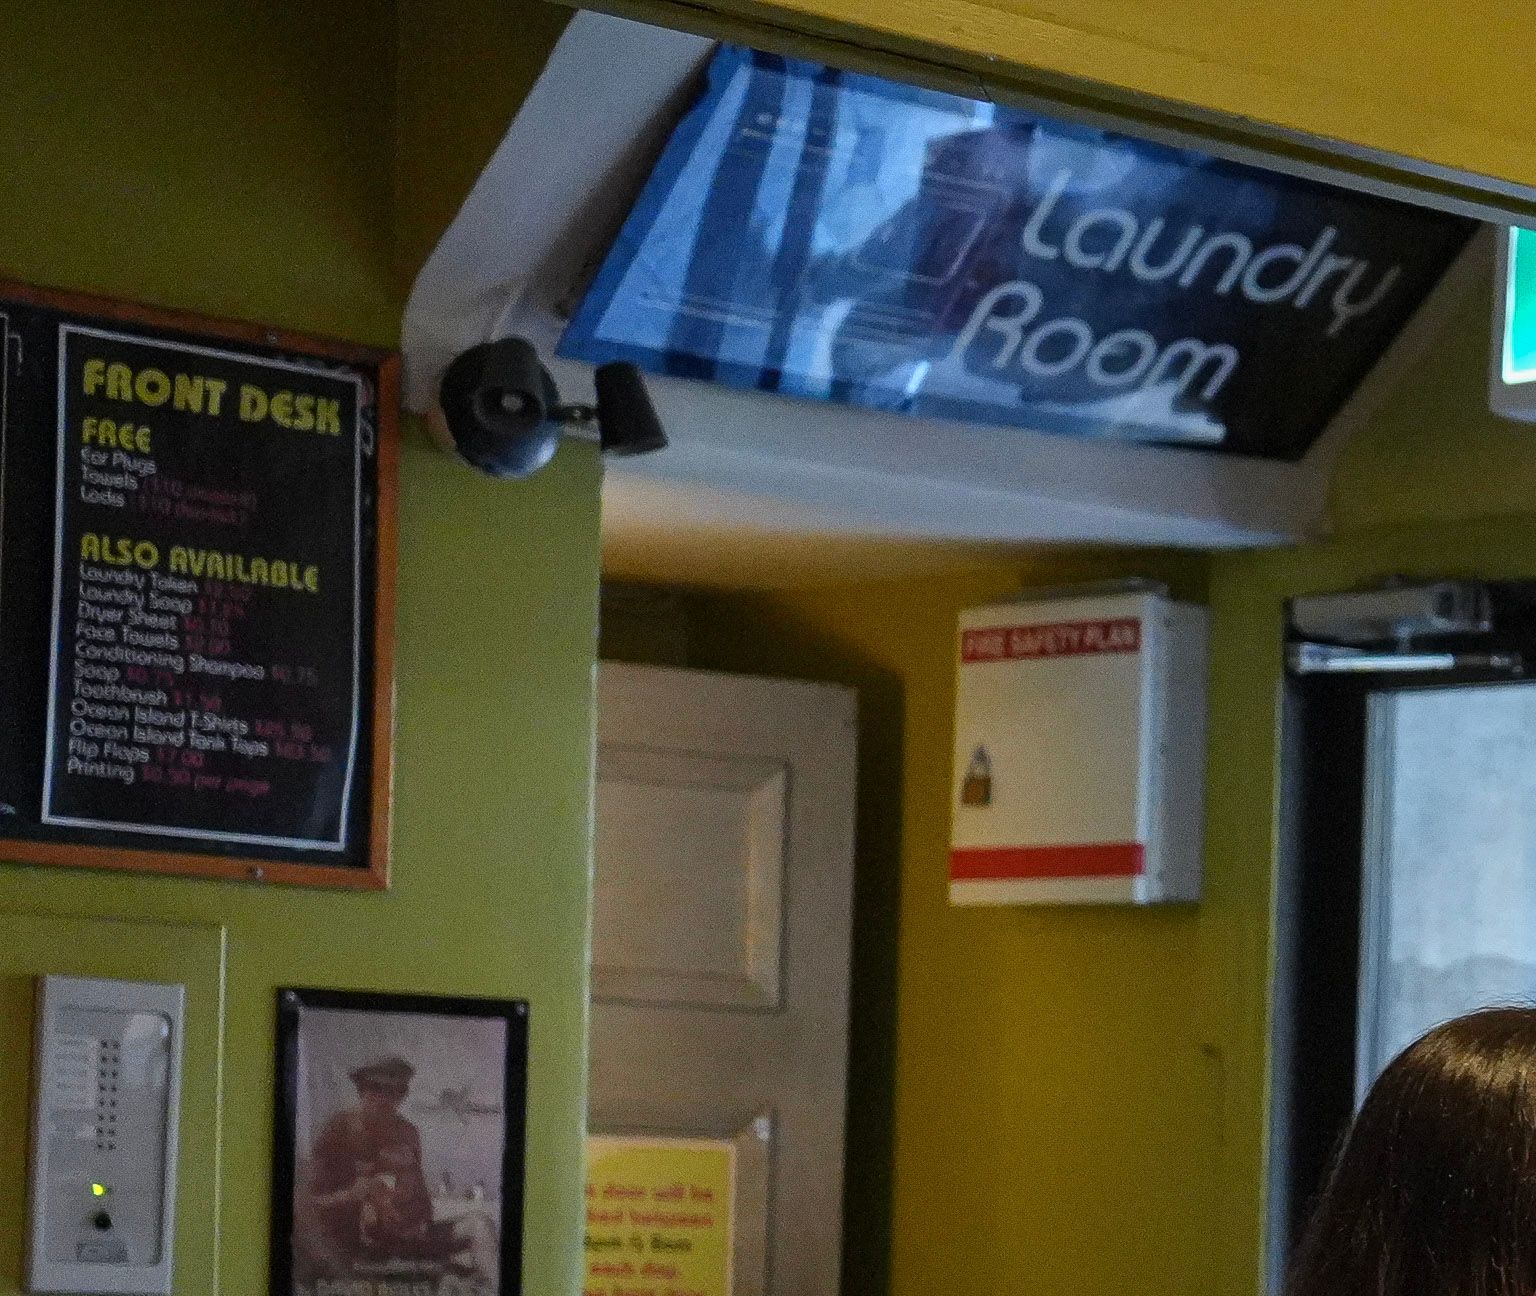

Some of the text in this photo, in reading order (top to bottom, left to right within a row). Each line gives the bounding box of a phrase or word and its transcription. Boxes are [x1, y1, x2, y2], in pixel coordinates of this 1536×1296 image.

[1022, 168, 1400, 337] Laundry
[955, 280, 1240, 400] Room
[82, 358, 338, 436] FRONT DESK
[82, 416, 151, 454] FREE
[82, 464, 138, 490] Towels
[112, 452, 157, 477] Plugs
[80, 563, 144, 589] Laundry
[81, 533, 159, 570] ALSO
[168, 545, 319, 592] AVAILABLE
[79, 600, 122, 622] Dryer
[80, 581, 144, 607] Laundry
[149, 590, 193, 614] Soap
[123, 625, 179, 650] Towels
[967, 621, 1136, 657] FIRE SAFETY PLAN
[74, 660, 120, 682] Soap
[75, 640, 184, 674] Conditioning
[188, 654, 265, 680] Shampoo
[74, 678, 168, 705] Toothbrush
[71, 698, 130, 721] Ocean
[135, 706, 184, 728] Island
[70, 717, 128, 740] Ocean
[133, 726, 184, 748] Island
[69, 736, 99, 759] Flip
[103, 741, 150, 763] Flops
[67, 755, 134, 785] Printing
